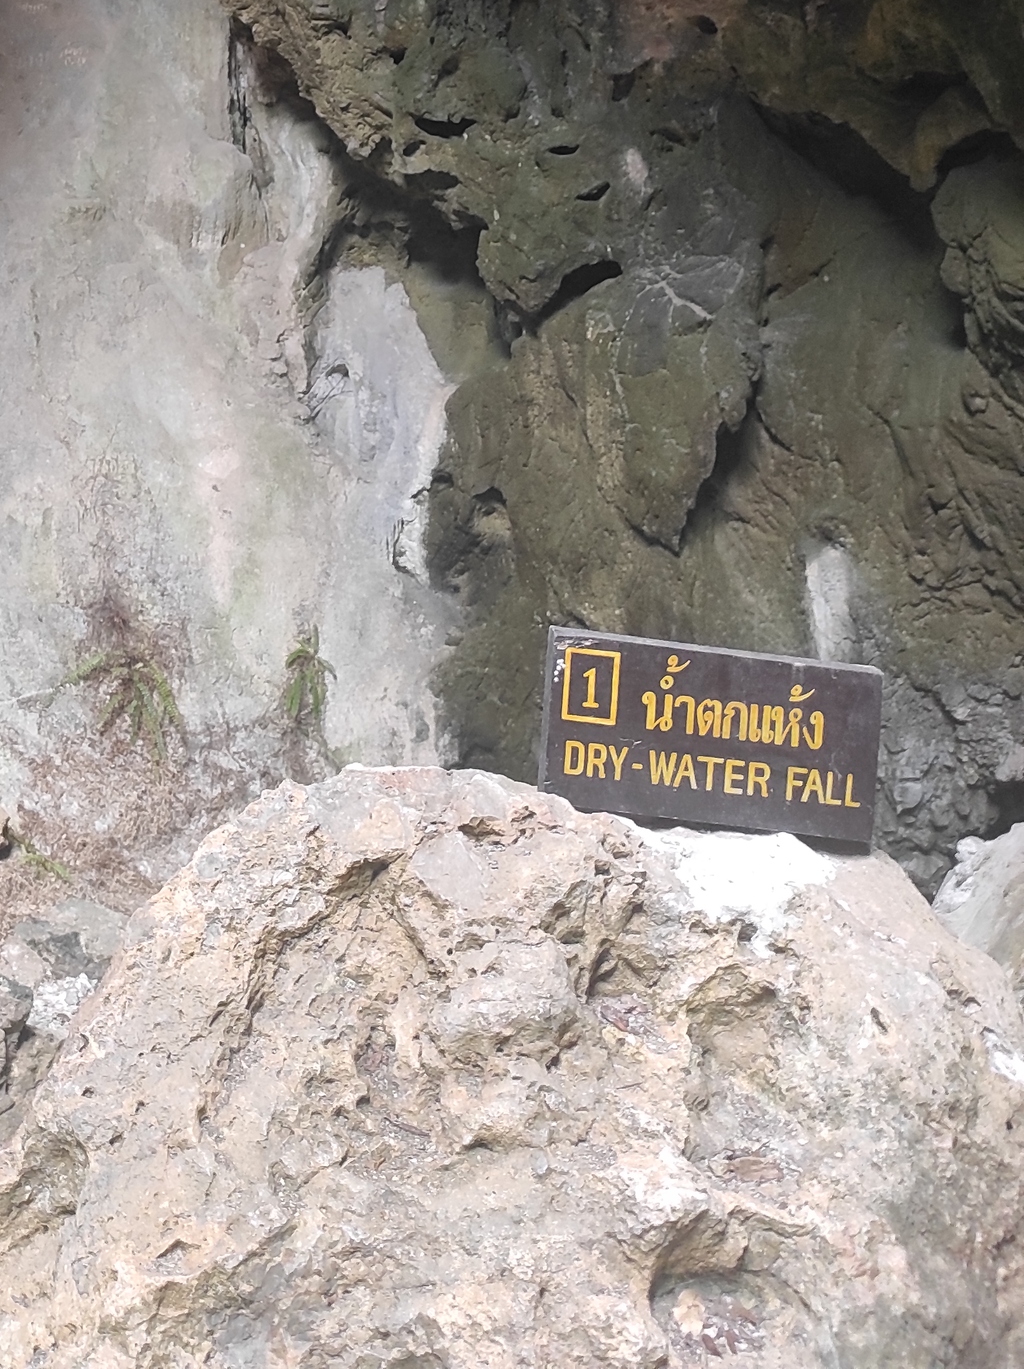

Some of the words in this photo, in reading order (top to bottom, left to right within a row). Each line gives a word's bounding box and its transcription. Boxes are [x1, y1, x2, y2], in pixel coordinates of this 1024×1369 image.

[581, 667, 600, 709] 1
[641, 654, 825, 750] น้ำตกแห้ง
[563, 739, 772, 798] DRY-WATER
[784, 766, 861, 807] FALL
